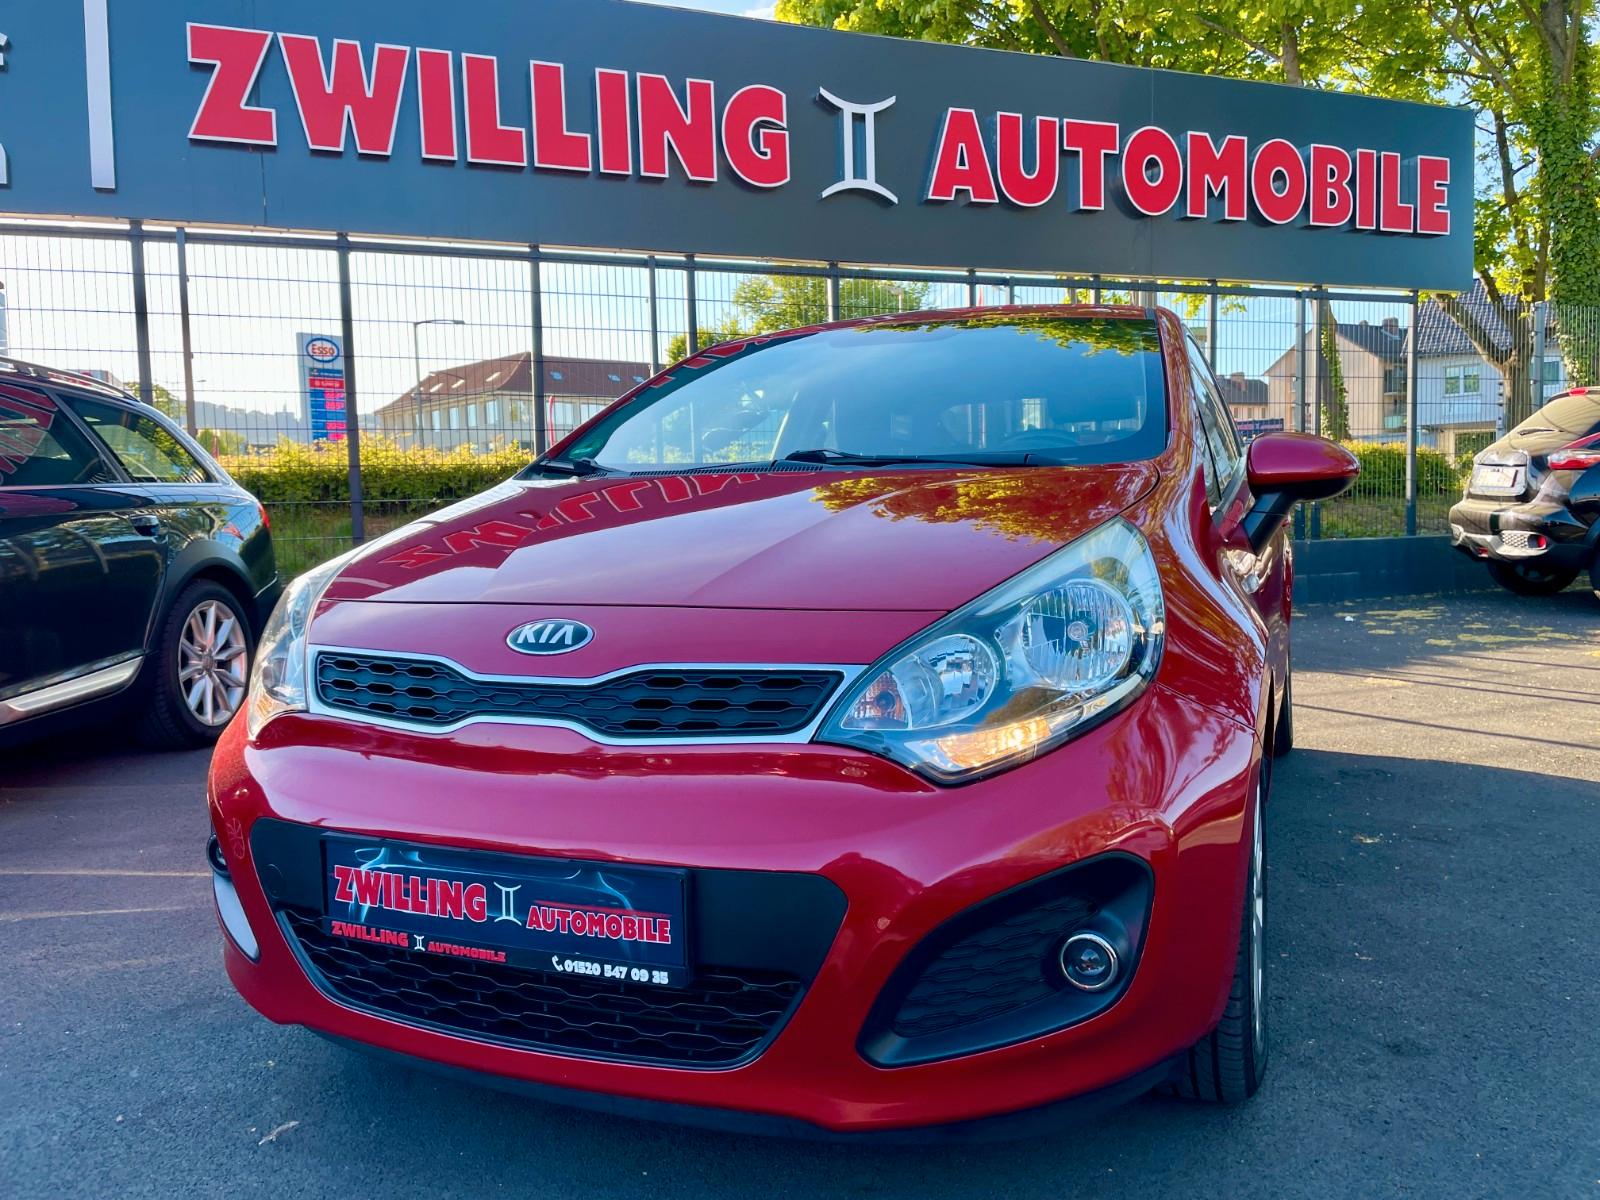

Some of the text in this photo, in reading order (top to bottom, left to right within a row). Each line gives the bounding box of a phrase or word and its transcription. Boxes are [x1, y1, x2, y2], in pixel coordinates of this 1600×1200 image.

[185, 21, 791, 188] ZWILLING
[927, 106, 1451, 237] AUTOMOBILE
[516, 623, 575, 645] KIA
[333, 864, 672, 944] ZWILLING AUTOMOBILE
[331, 920, 507, 963] ZWILLING AUTOMOBILE
[564, 959, 602, 976] 01520
[603, 964, 628, 979] 547
